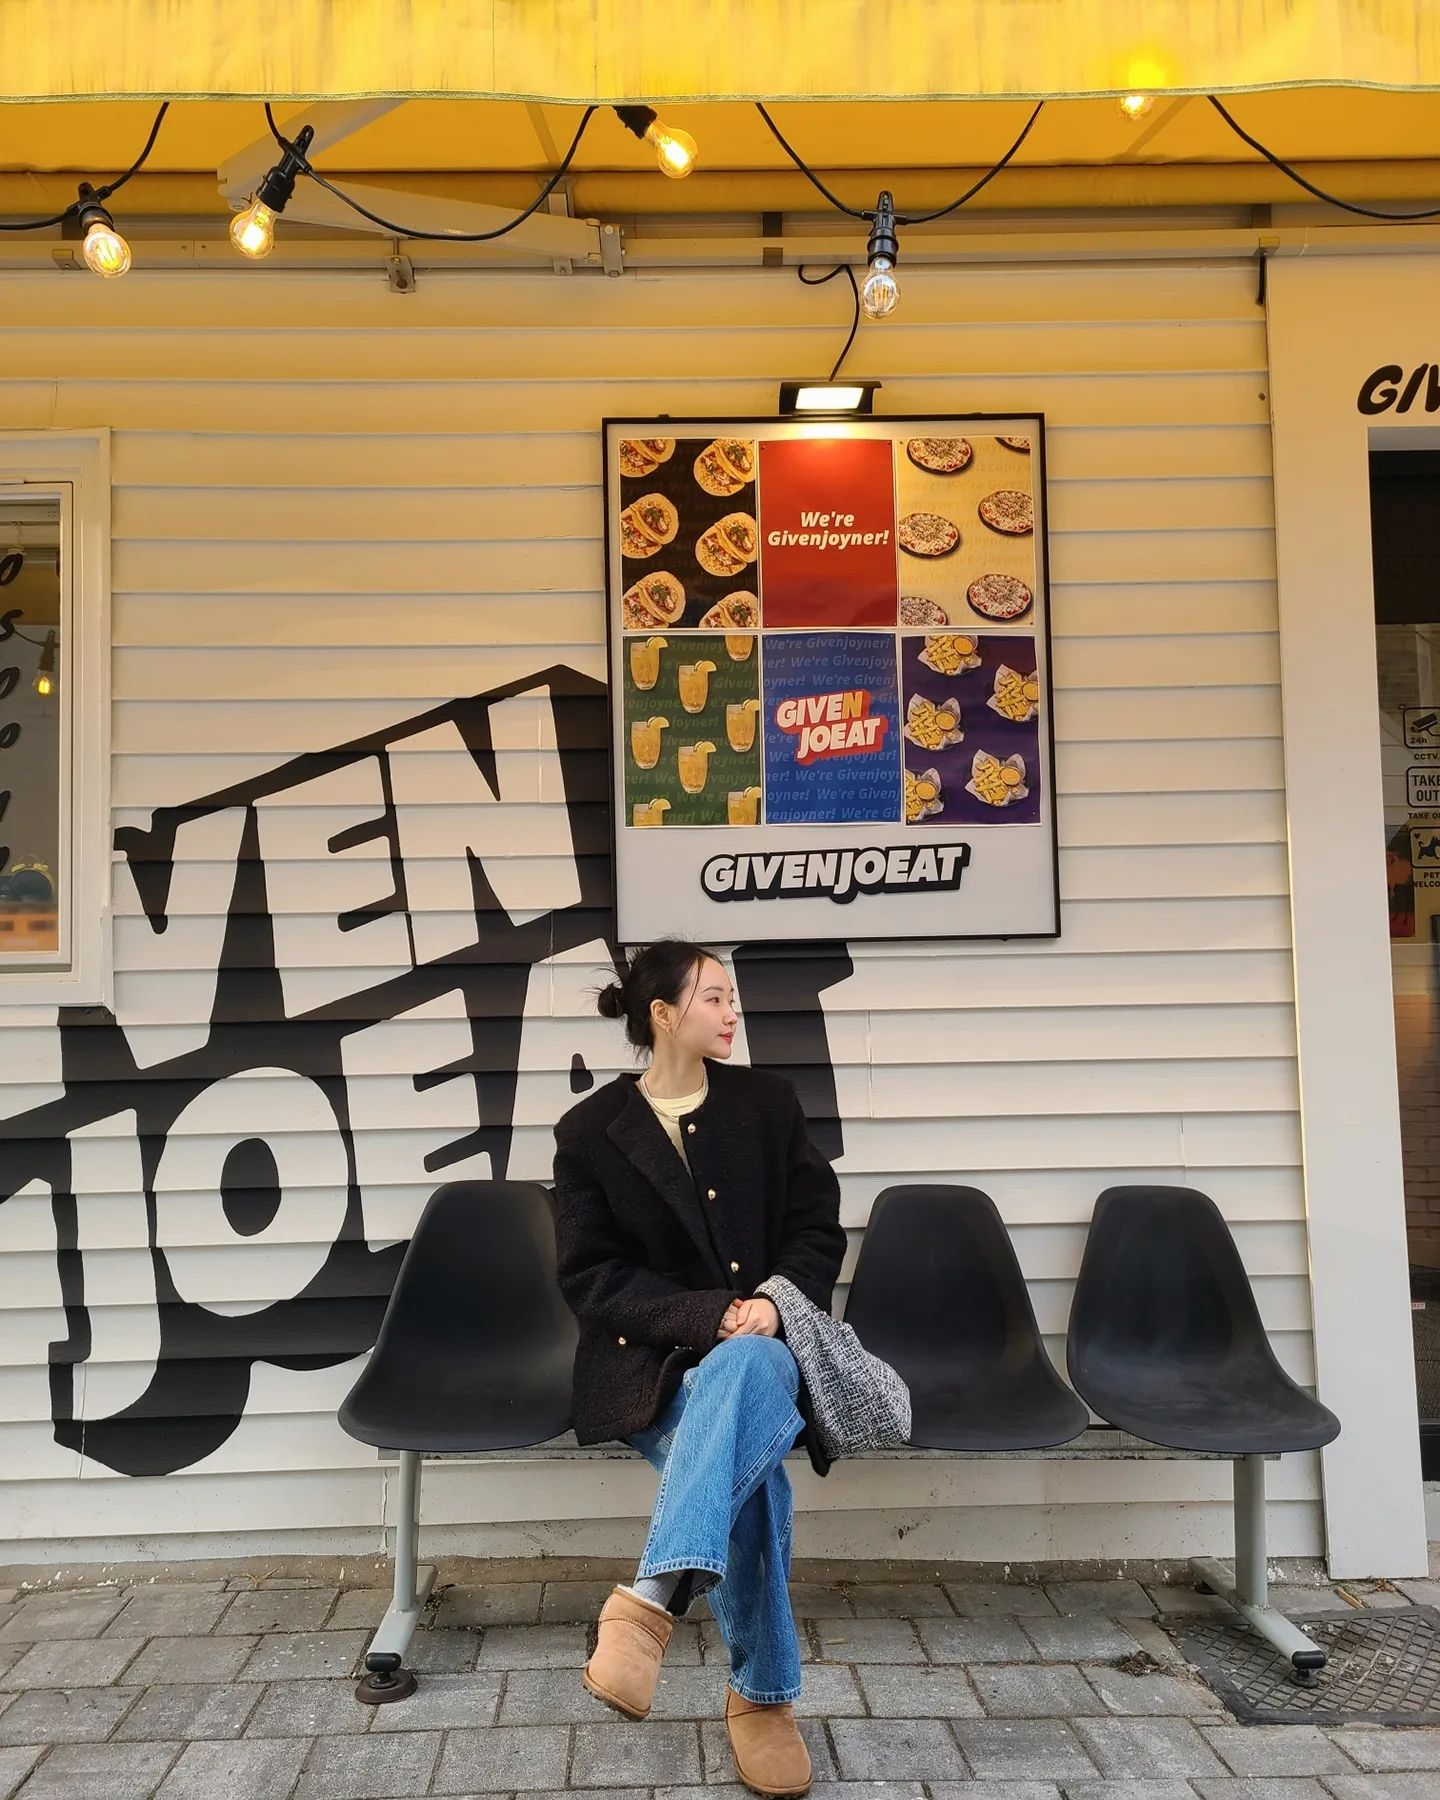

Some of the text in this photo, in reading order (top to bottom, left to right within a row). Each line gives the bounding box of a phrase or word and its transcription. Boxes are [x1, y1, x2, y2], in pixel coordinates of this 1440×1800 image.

[800, 511, 855, 527] We're
[767, 529, 890, 550] Givenjoyner!
[776, 690, 863, 729] GIVEN
[797, 717, 881, 760] JOEAT
[1416, 790, 1440, 801] OUT
[704, 846, 963, 895] GIVENJOEAT
